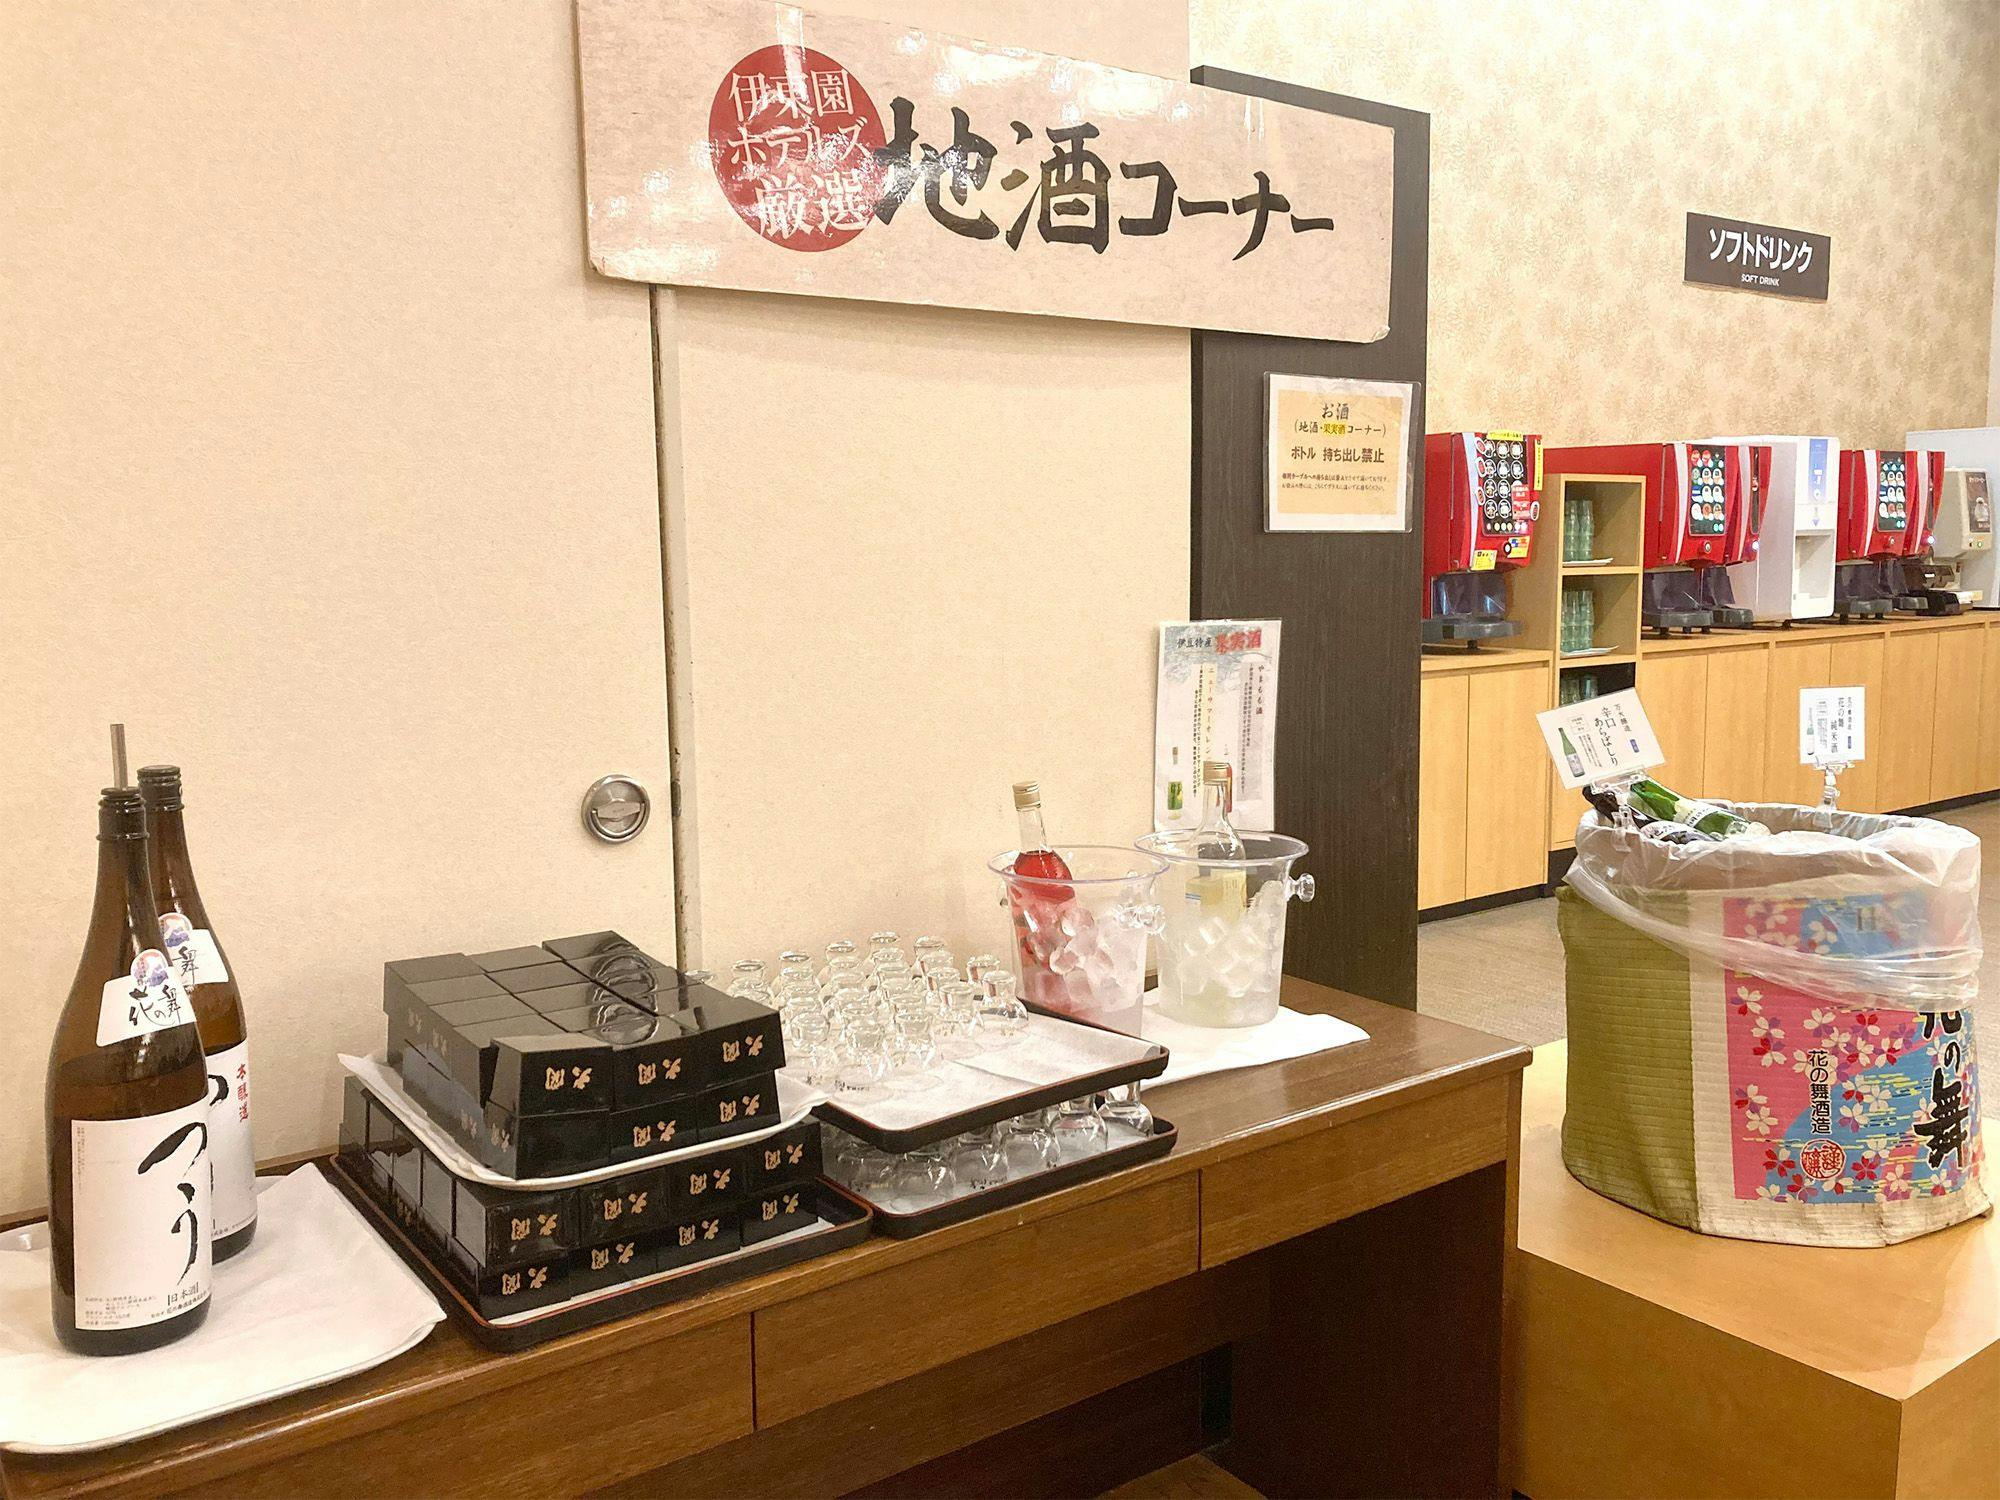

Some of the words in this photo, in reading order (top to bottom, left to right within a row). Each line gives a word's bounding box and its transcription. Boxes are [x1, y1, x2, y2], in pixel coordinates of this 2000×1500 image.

[728, 68, 855, 122] 伊東園
[727, 116, 874, 169] ホテルズ
[754, 169, 873, 240] 厳選
[872, 96, 1335, 262] 地酒コーナー
[1709, 228, 1813, 274] ソフトドリンク
[1741, 273, 1758, 284] SOFT
[1759, 275, 1780, 287] DRINK
[1321, 403, 1350, 420] お酒
[1291, 446, 1316, 460] ボトル
[1323, 447, 1385, 464] 持ち出し禁止
[236, 1063, 249, 1123] 本醸造
[1808, 1049, 1832, 1135] 花の舞酒造
